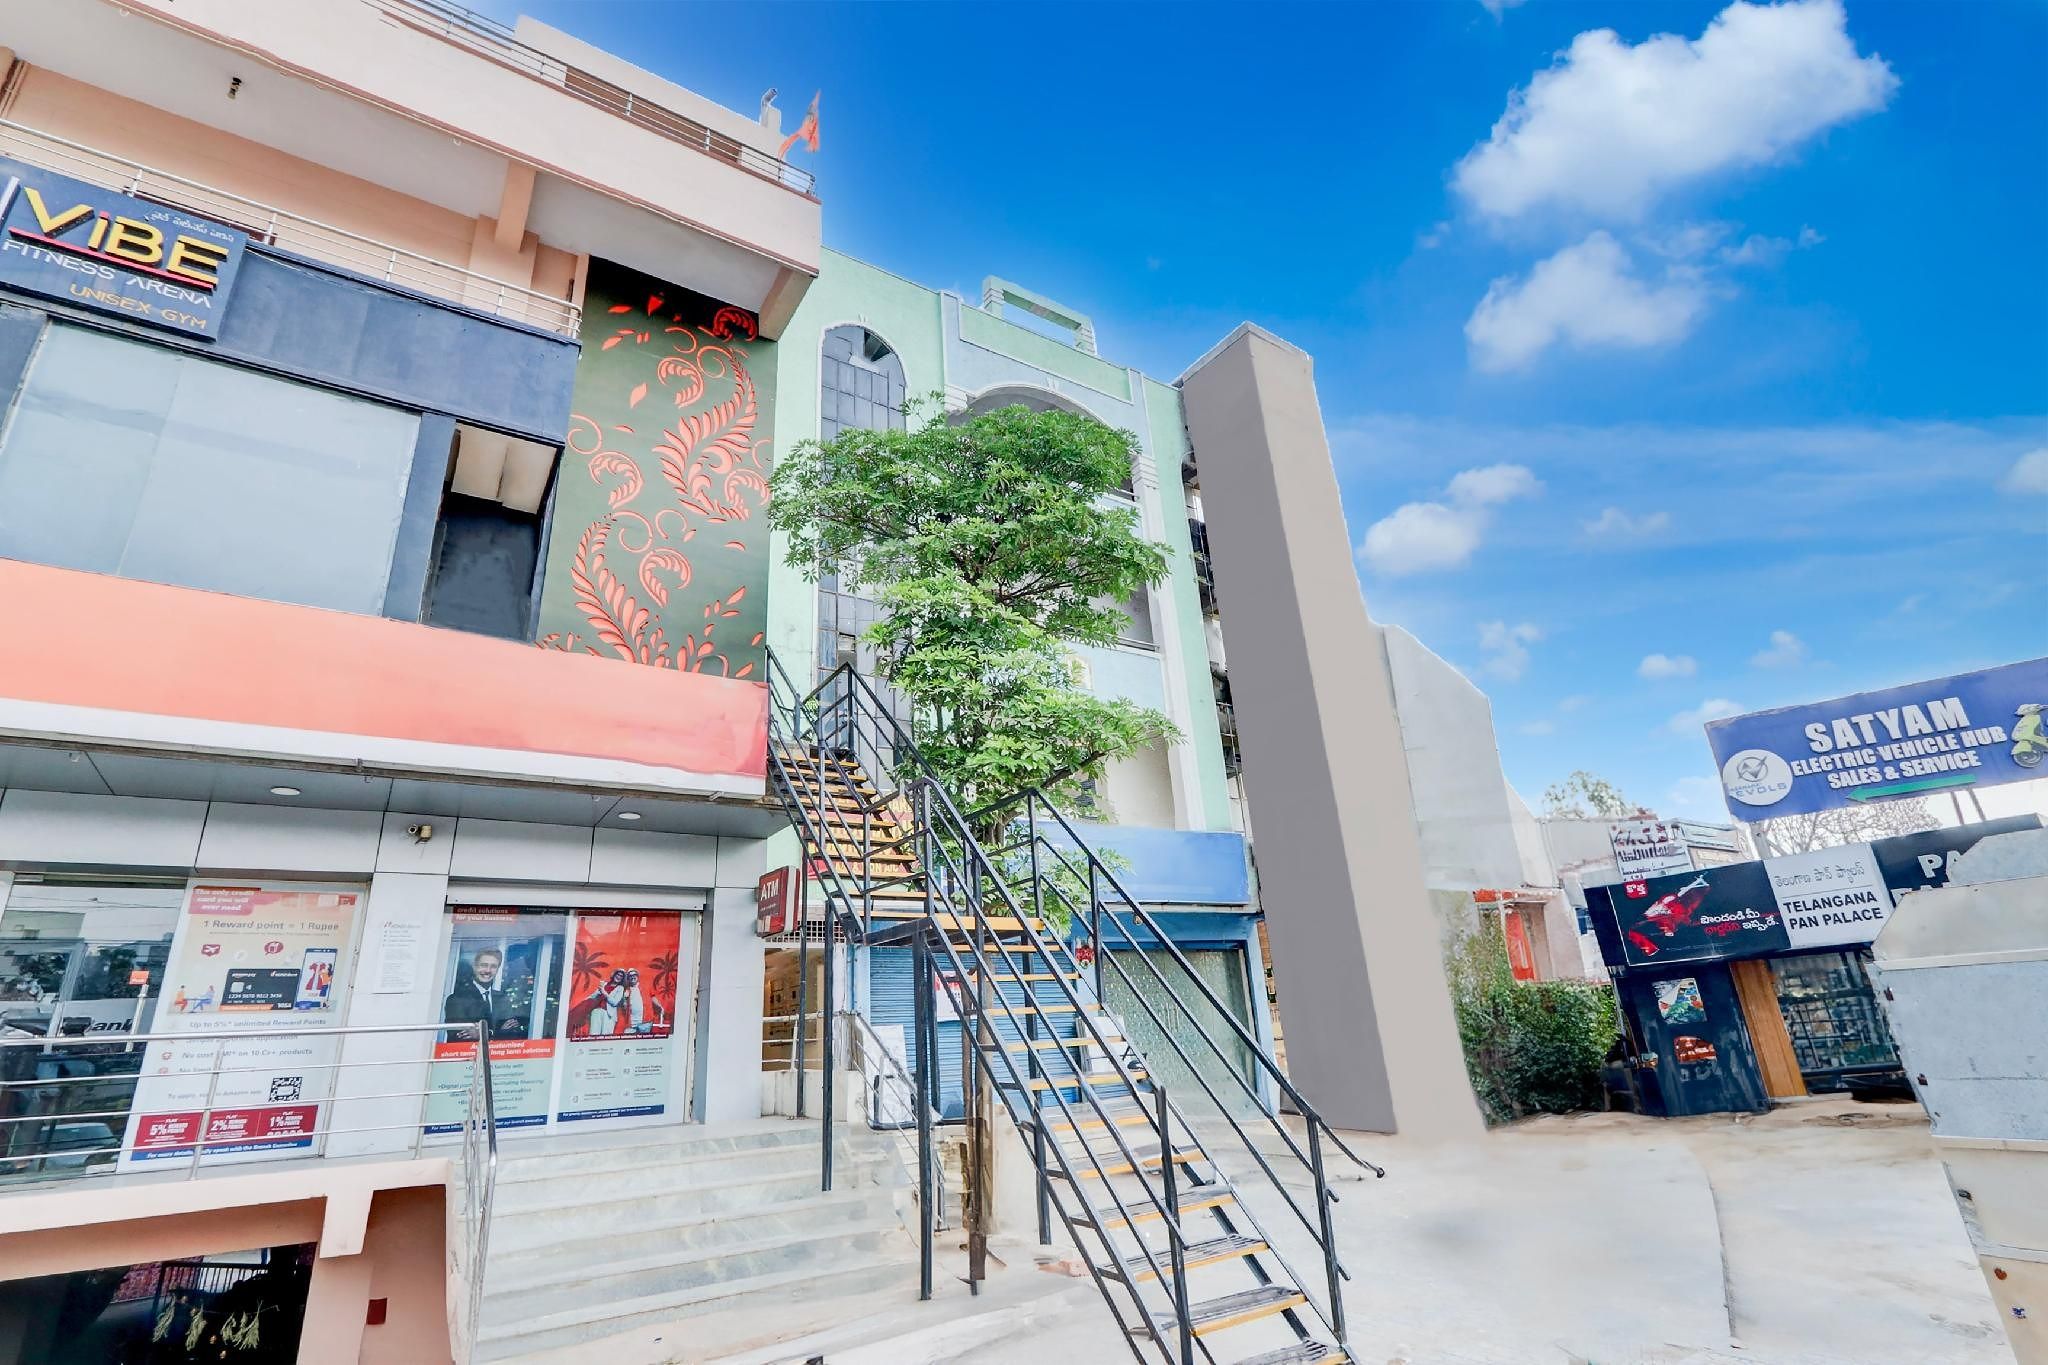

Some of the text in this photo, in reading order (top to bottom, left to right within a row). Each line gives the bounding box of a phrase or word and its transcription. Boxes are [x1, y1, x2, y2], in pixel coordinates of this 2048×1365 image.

[4, 238, 212, 309] FITNESS ARENA
[70, 283, 207, 330] UNISEX GYM
[1804, 697, 1970, 754] SATYAM
[1791, 726, 2008, 777] ELECTRIC VEHICLE HUB
[1827, 751, 1982, 790] SALES & SERVICE
[760, 878, 780, 901] ATM
[1782, 890, 1878, 914] TELANGANA
[212, 920, 254, 929] Reward
[256, 920, 284, 930] point
[308, 921, 340, 931] Rupee
[1788, 907, 1884, 931] PAN PALACE
